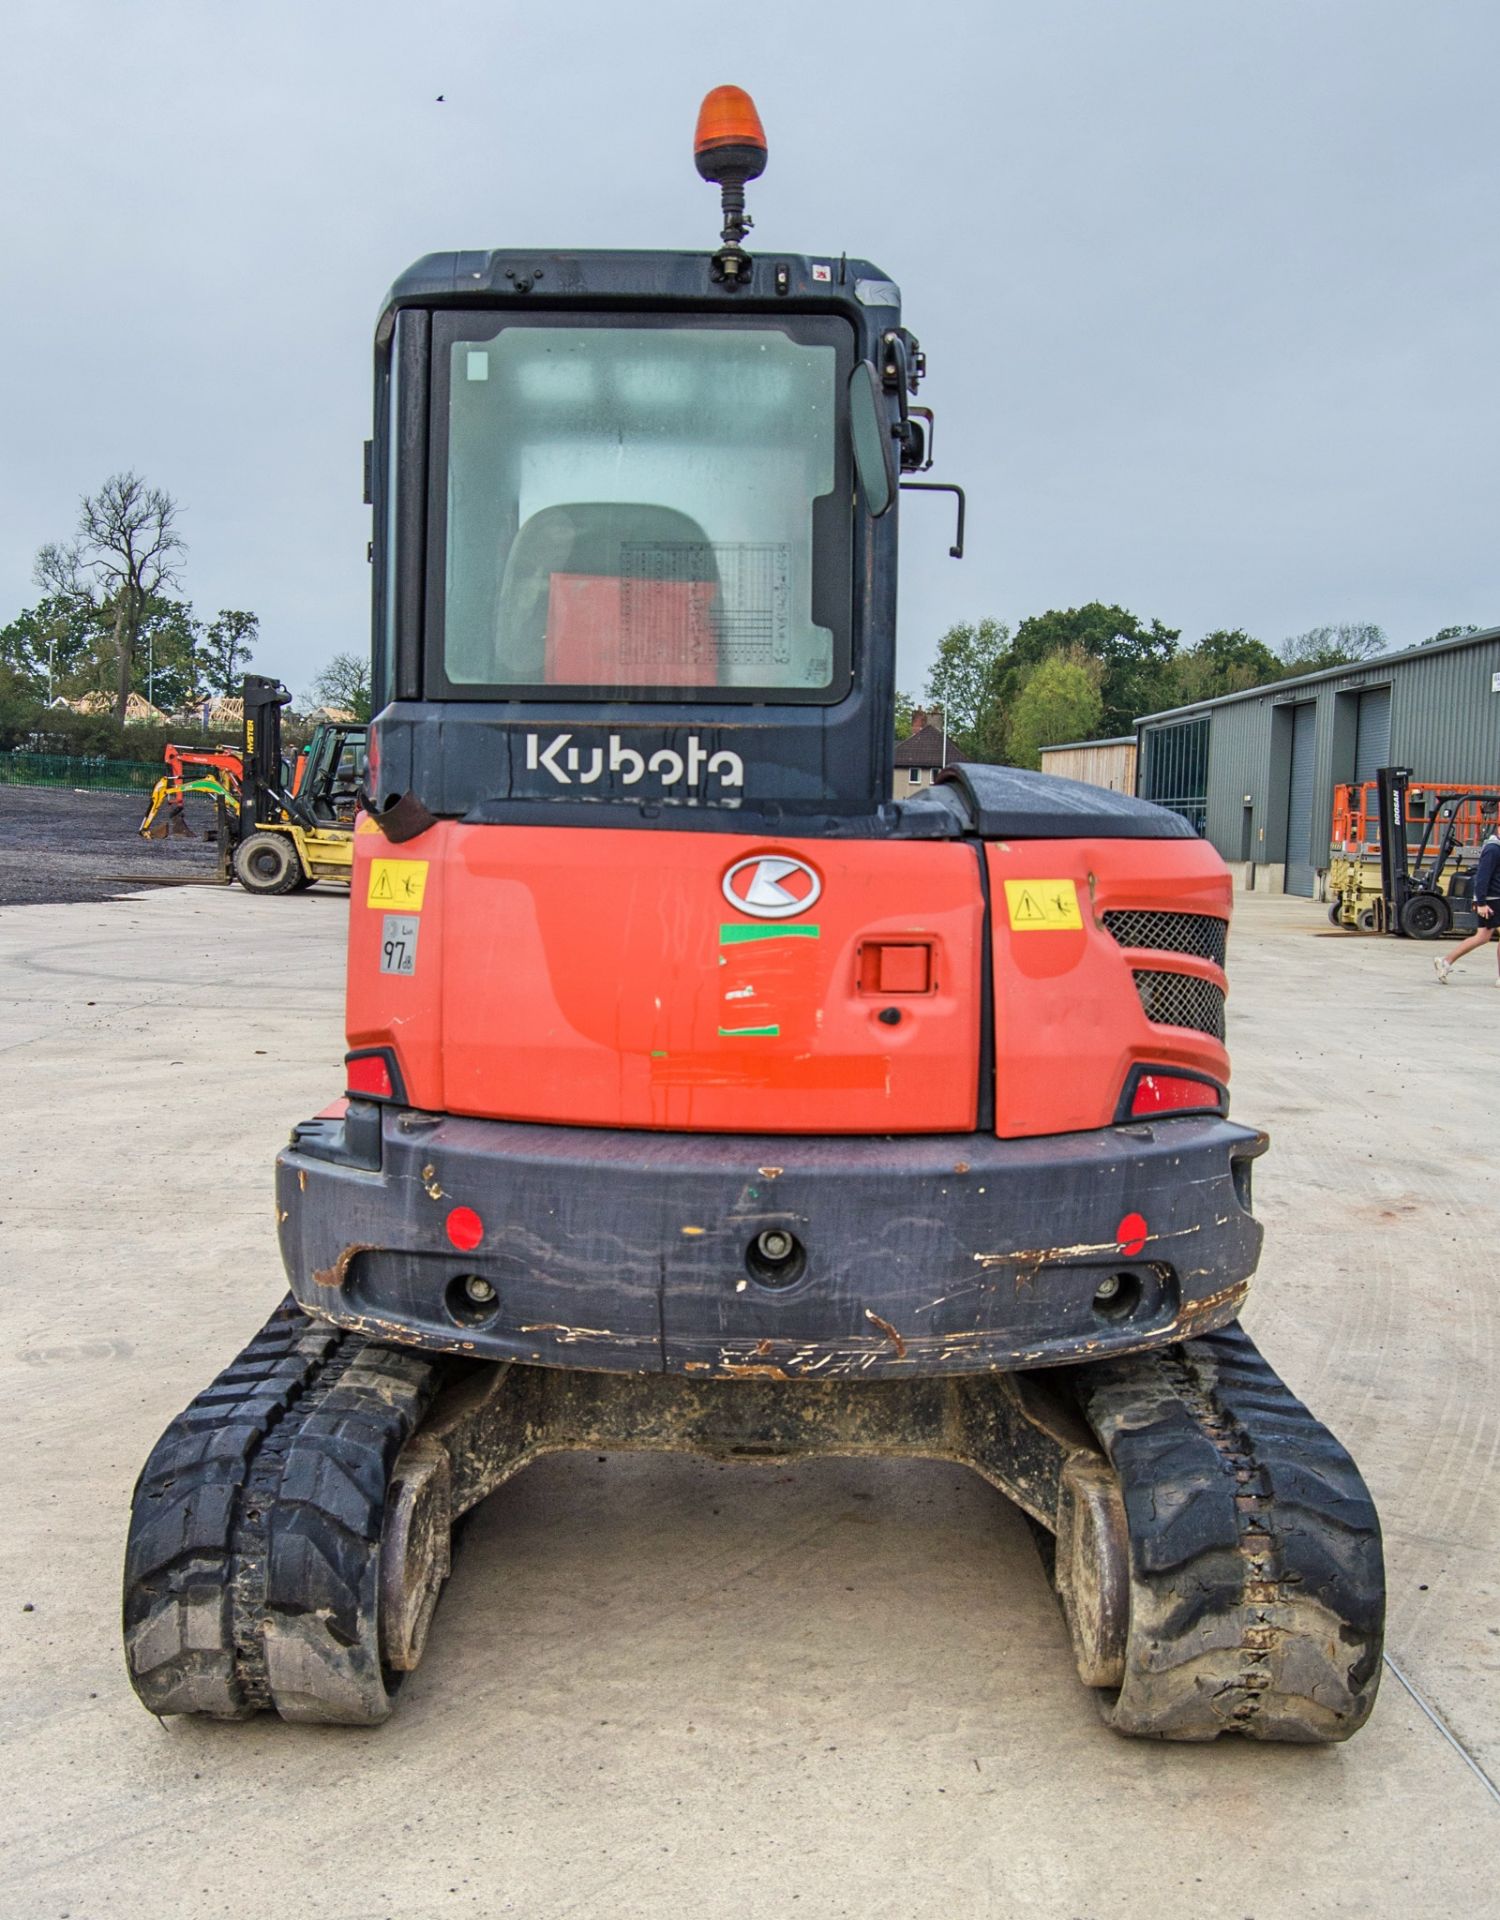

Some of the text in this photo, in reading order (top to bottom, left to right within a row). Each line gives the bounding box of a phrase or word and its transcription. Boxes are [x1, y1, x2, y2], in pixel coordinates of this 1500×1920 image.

[246, 719, 255, 754] HYSTER
[526, 733, 744, 786] Kubota
[1393, 789, 1401, 826] DOOSAN
[384, 940, 406, 969] 97
